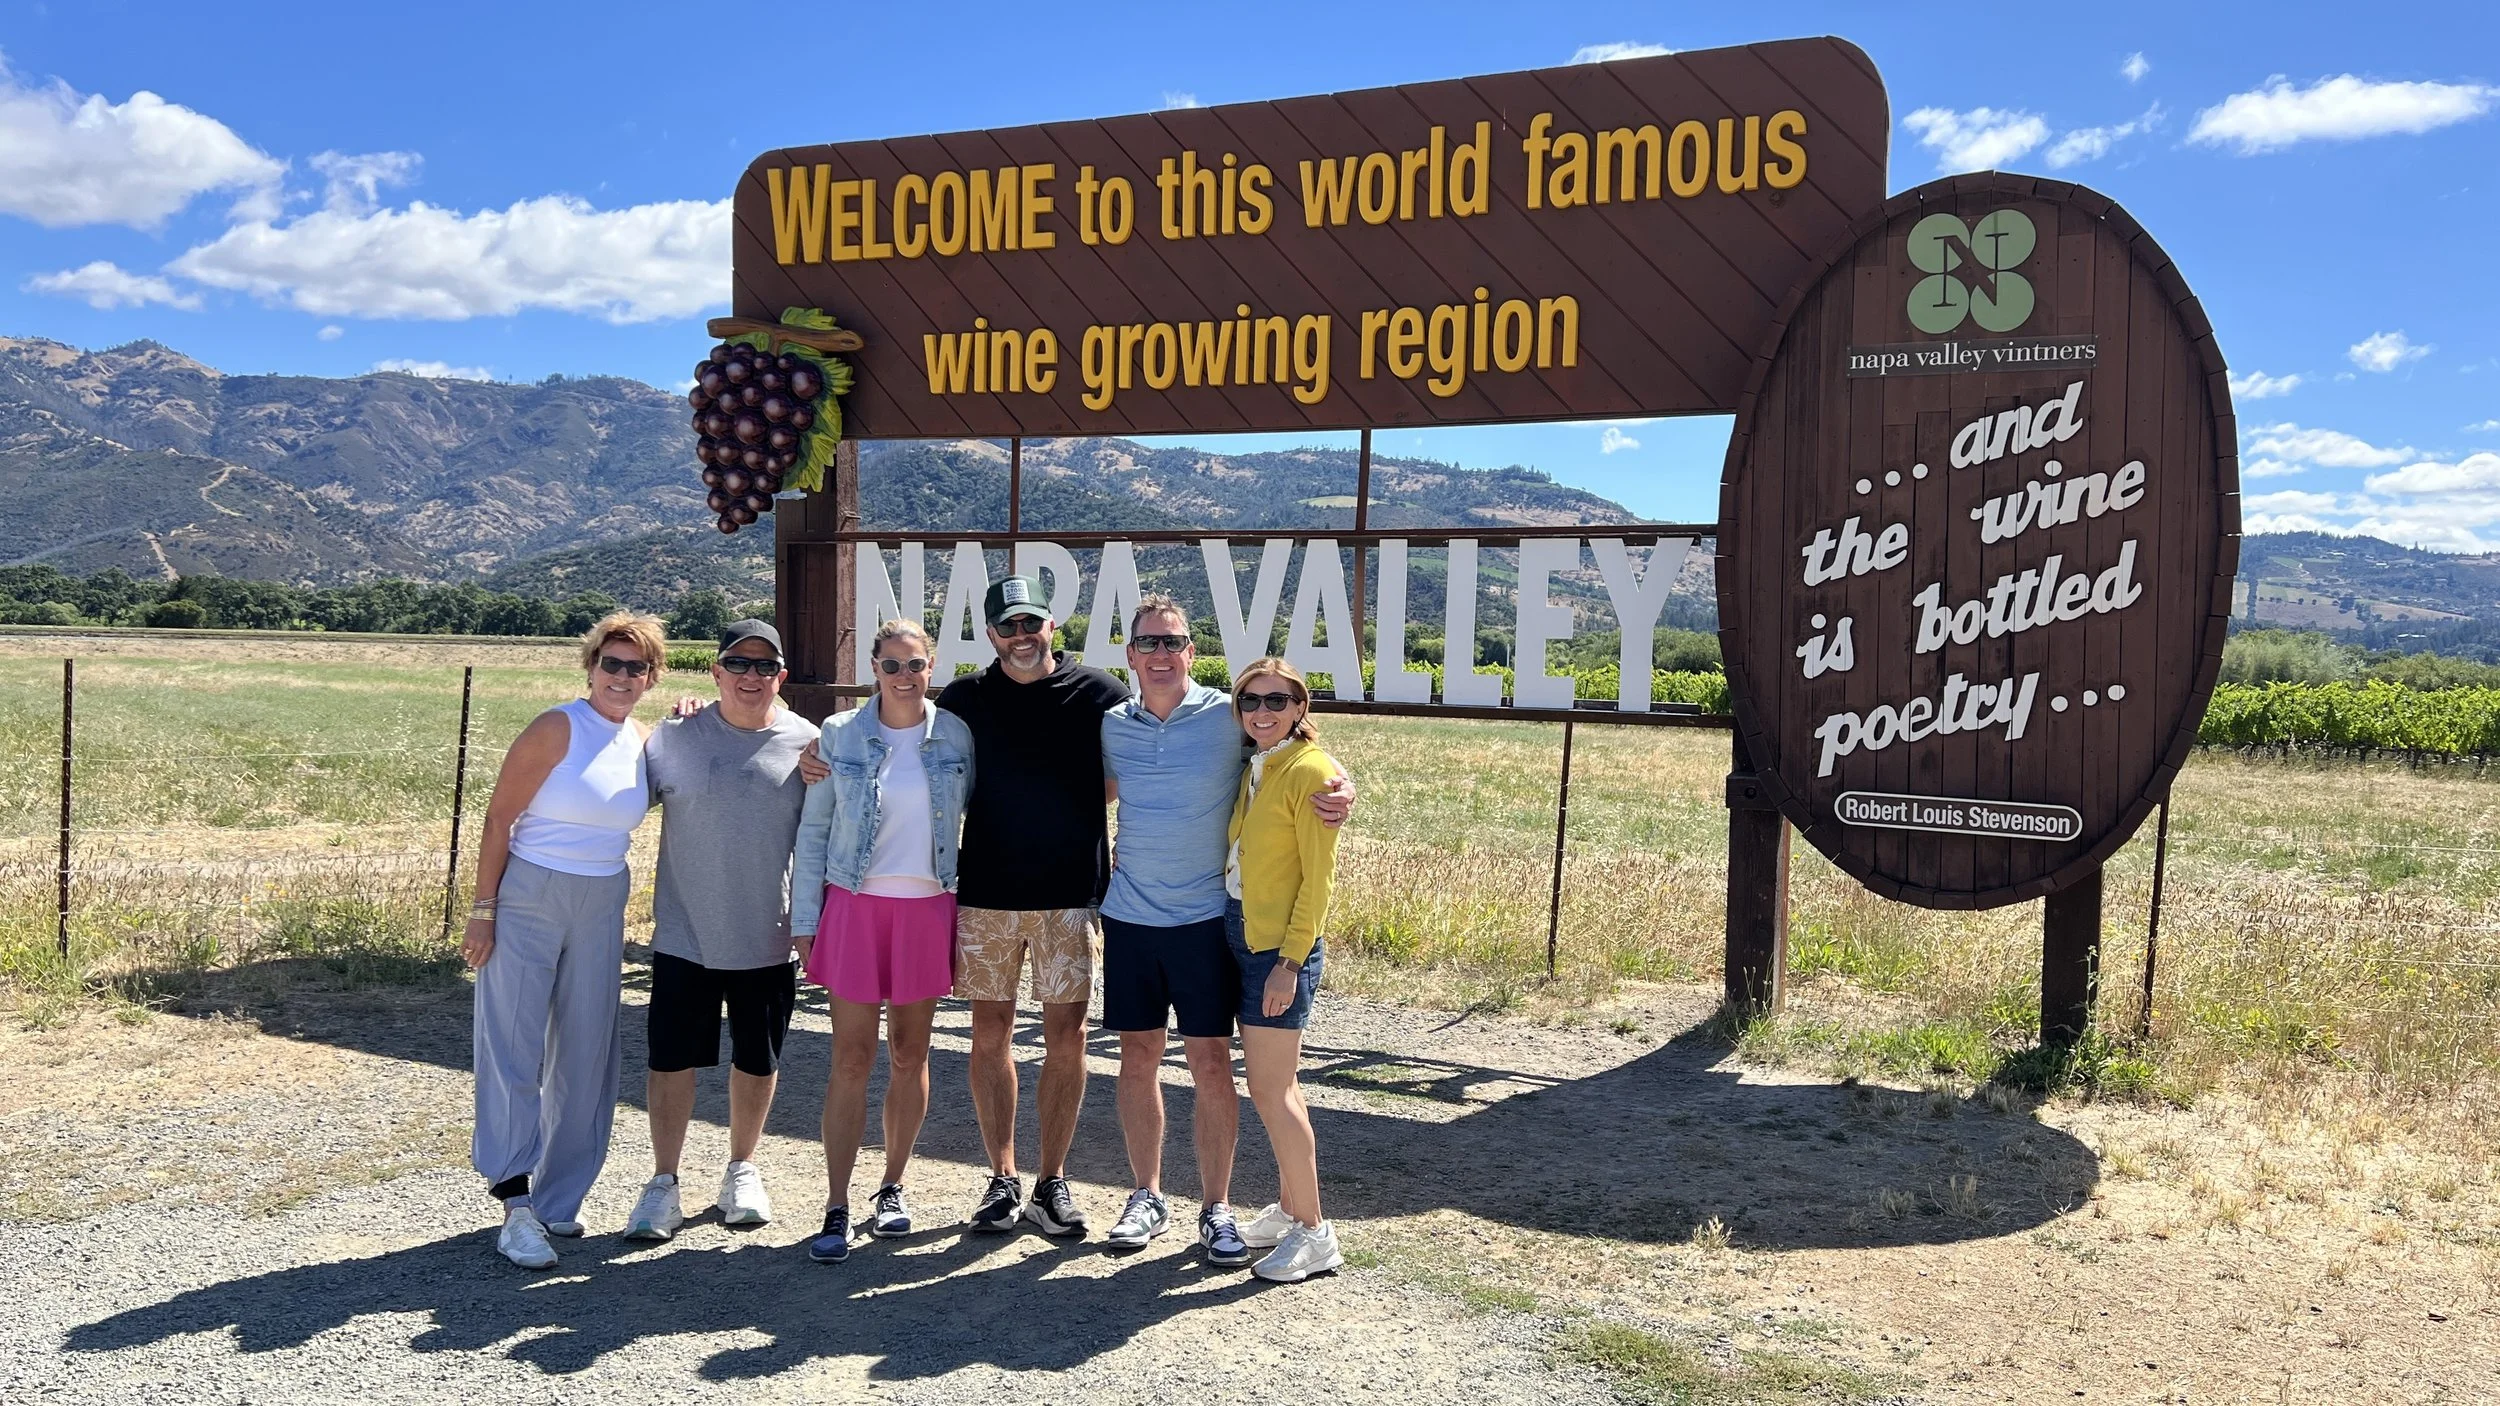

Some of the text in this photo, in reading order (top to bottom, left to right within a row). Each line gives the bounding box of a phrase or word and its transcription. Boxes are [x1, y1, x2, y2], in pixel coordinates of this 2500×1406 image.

[767, 111, 1808, 265] WELCOME to this world famous
[924, 286, 1580, 411] wine growing region
[1850, 341, 2097, 376] napa valley vintners
[1801, 460, 2146, 587] the wine
[856, 537, 1695, 712] NAPA VALLEY
[1796, 540, 2143, 680] is bottled
[1846, 798, 2071, 834] Robert Louis Stevenson
